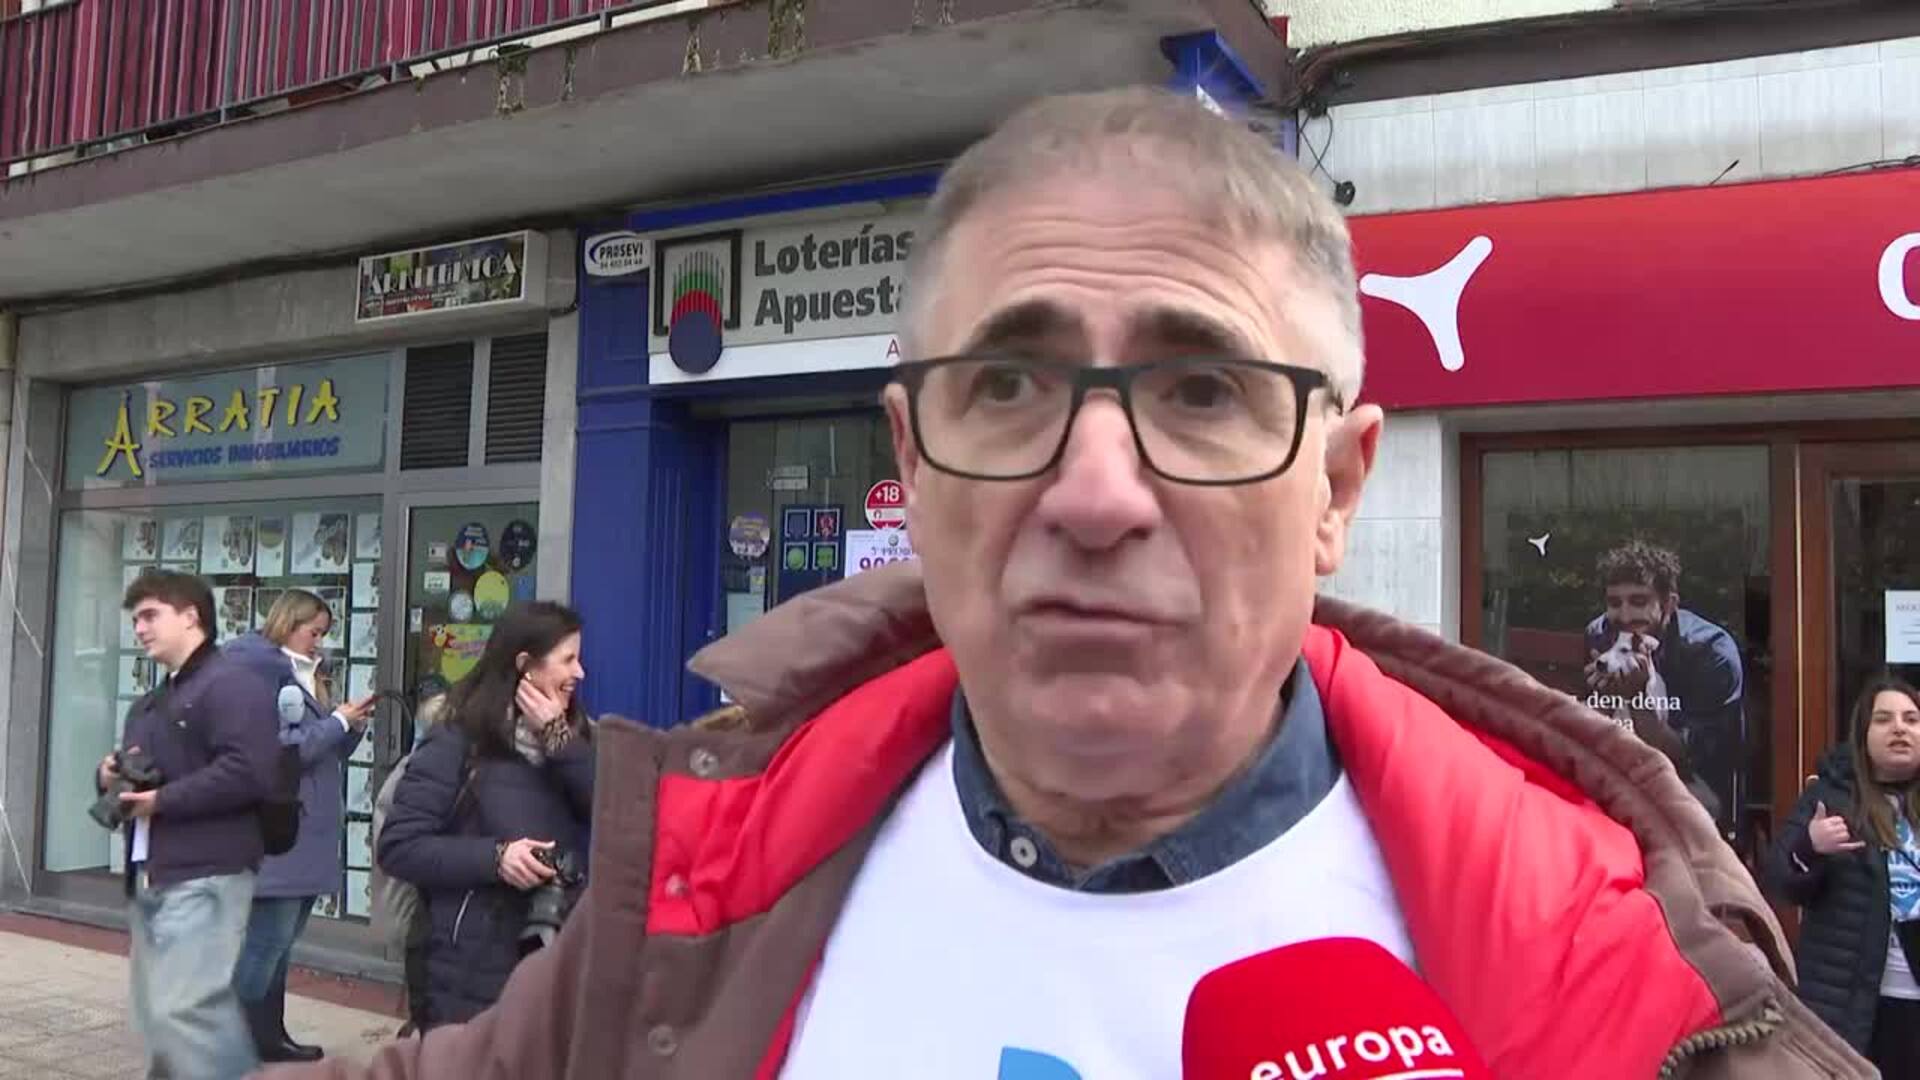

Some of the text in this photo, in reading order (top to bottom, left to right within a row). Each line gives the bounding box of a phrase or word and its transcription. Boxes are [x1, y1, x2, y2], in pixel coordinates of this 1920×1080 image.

[755, 224, 914, 277] Loterías
[754, 275, 904, 334] Apuest
[96, 377, 340, 478] ARRATIA
[149, 436, 341, 468] SERVICIOS INMOBILIARIOS
[1250, 1025, 1454, 1080] europa
